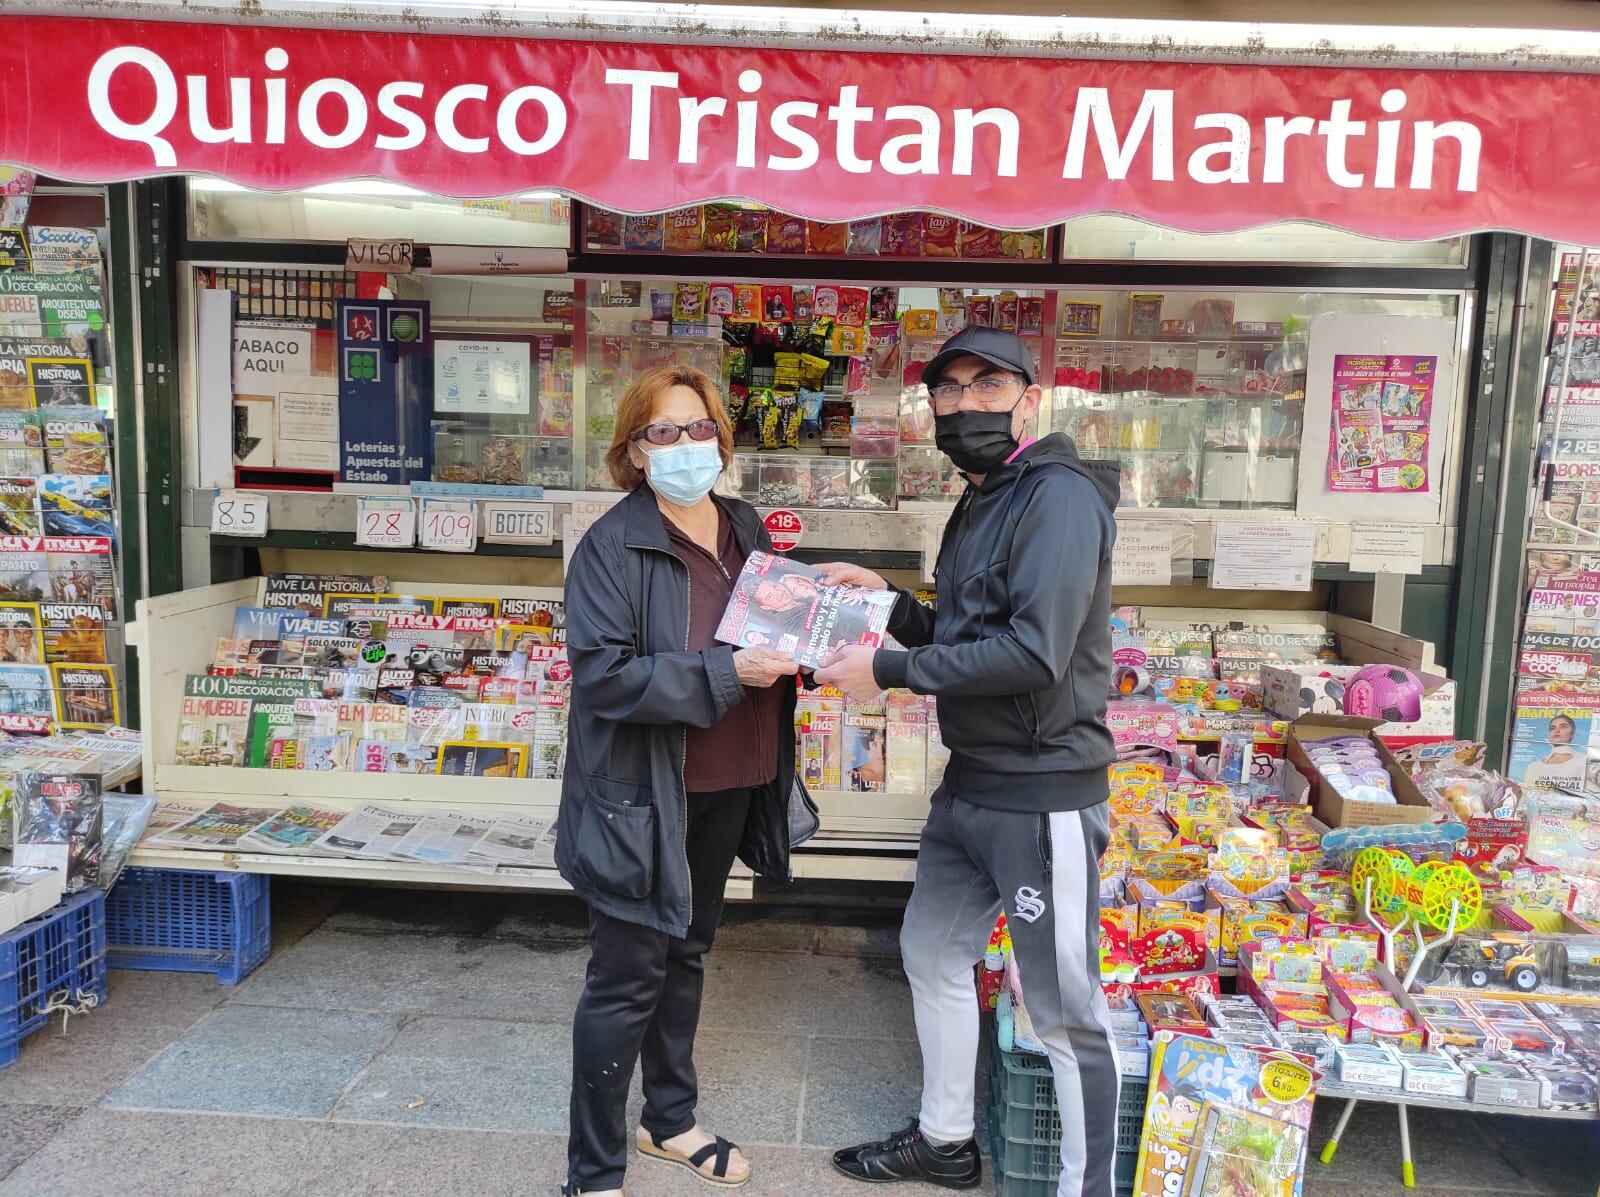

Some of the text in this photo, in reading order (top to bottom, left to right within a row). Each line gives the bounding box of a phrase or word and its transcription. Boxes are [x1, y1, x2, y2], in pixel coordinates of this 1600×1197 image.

[87, 46, 1482, 193] Quiosco Tristan Martin
[674, 217, 698, 228] Bits
[349, 242, 413, 266] VISOR
[13, 281, 84, 293] DECORACIÓN
[42, 299, 102, 310] ARQUITECTURA
[18, 344, 73, 357] HISTORIA
[233, 340, 299, 355] TABACO
[244, 358, 284, 373] AQUI
[38, 368, 83, 381] HISTORIA
[1547, 407, 1589, 416] AMADA
[46, 421, 99, 434] COCINA
[345, 441, 405, 456] Loterías y
[1562, 440, 1572, 454] 2
[346, 455, 403, 470] Apuestas
[405, 457, 423, 469] del
[346, 470, 389, 482] Estado
[217, 500, 256, 527] 85
[365, 512, 401, 536] 28
[428, 513, 471, 538] 109
[496, 513, 544, 535] BOTES
[1120, 535, 1141, 543] este
[1121, 568, 1157, 577] tarjeta
[1136, 561, 1157, 570] pago
[1576, 573, 1598, 583] Crea
[271, 580, 371, 596] VIVE LA HISTORIA
[1554, 581, 1595, 592] tu propia
[265, 593, 323, 609] HISTORIA
[1532, 592, 1600, 607] PATRNES
[41, 604, 103, 621] HISTORIA
[447, 607, 487, 617] HISTORIA
[284, 618, 340, 634] VIAJES
[389, 614, 455, 630] muy
[308, 639, 329, 650] SOLO
[799, 654, 812, 665] El
[806, 613, 824, 658] emotivo
[1216, 633, 1238, 646] MÁS
[1240, 635, 1255, 646] DE
[1258, 633, 1286, 648] 100
[1525, 633, 1551, 647] MÁS
[1552, 637, 1570, 648] DE
[366, 649, 386, 662] Life
[472, 656, 515, 668] HISTORIA
[1521, 653, 1565, 665] SABER
[1223, 659, 1249, 674] MÁS
[1529, 662, 1588, 676] COCINAR
[62, 673, 105, 685] HISTORIA
[381, 670, 415, 680] AUTO
[229, 685, 304, 698] DECORACIÓN
[184, 699, 249, 718] EL MUEBLE
[338, 704, 352, 722] EL
[810, 716, 834, 731] más
[1420, 745, 1455, 760] BFF
[1535, 780, 1581, 791] ESENCIAL
[1267, 1064, 1310, 1082] GIGANTE
